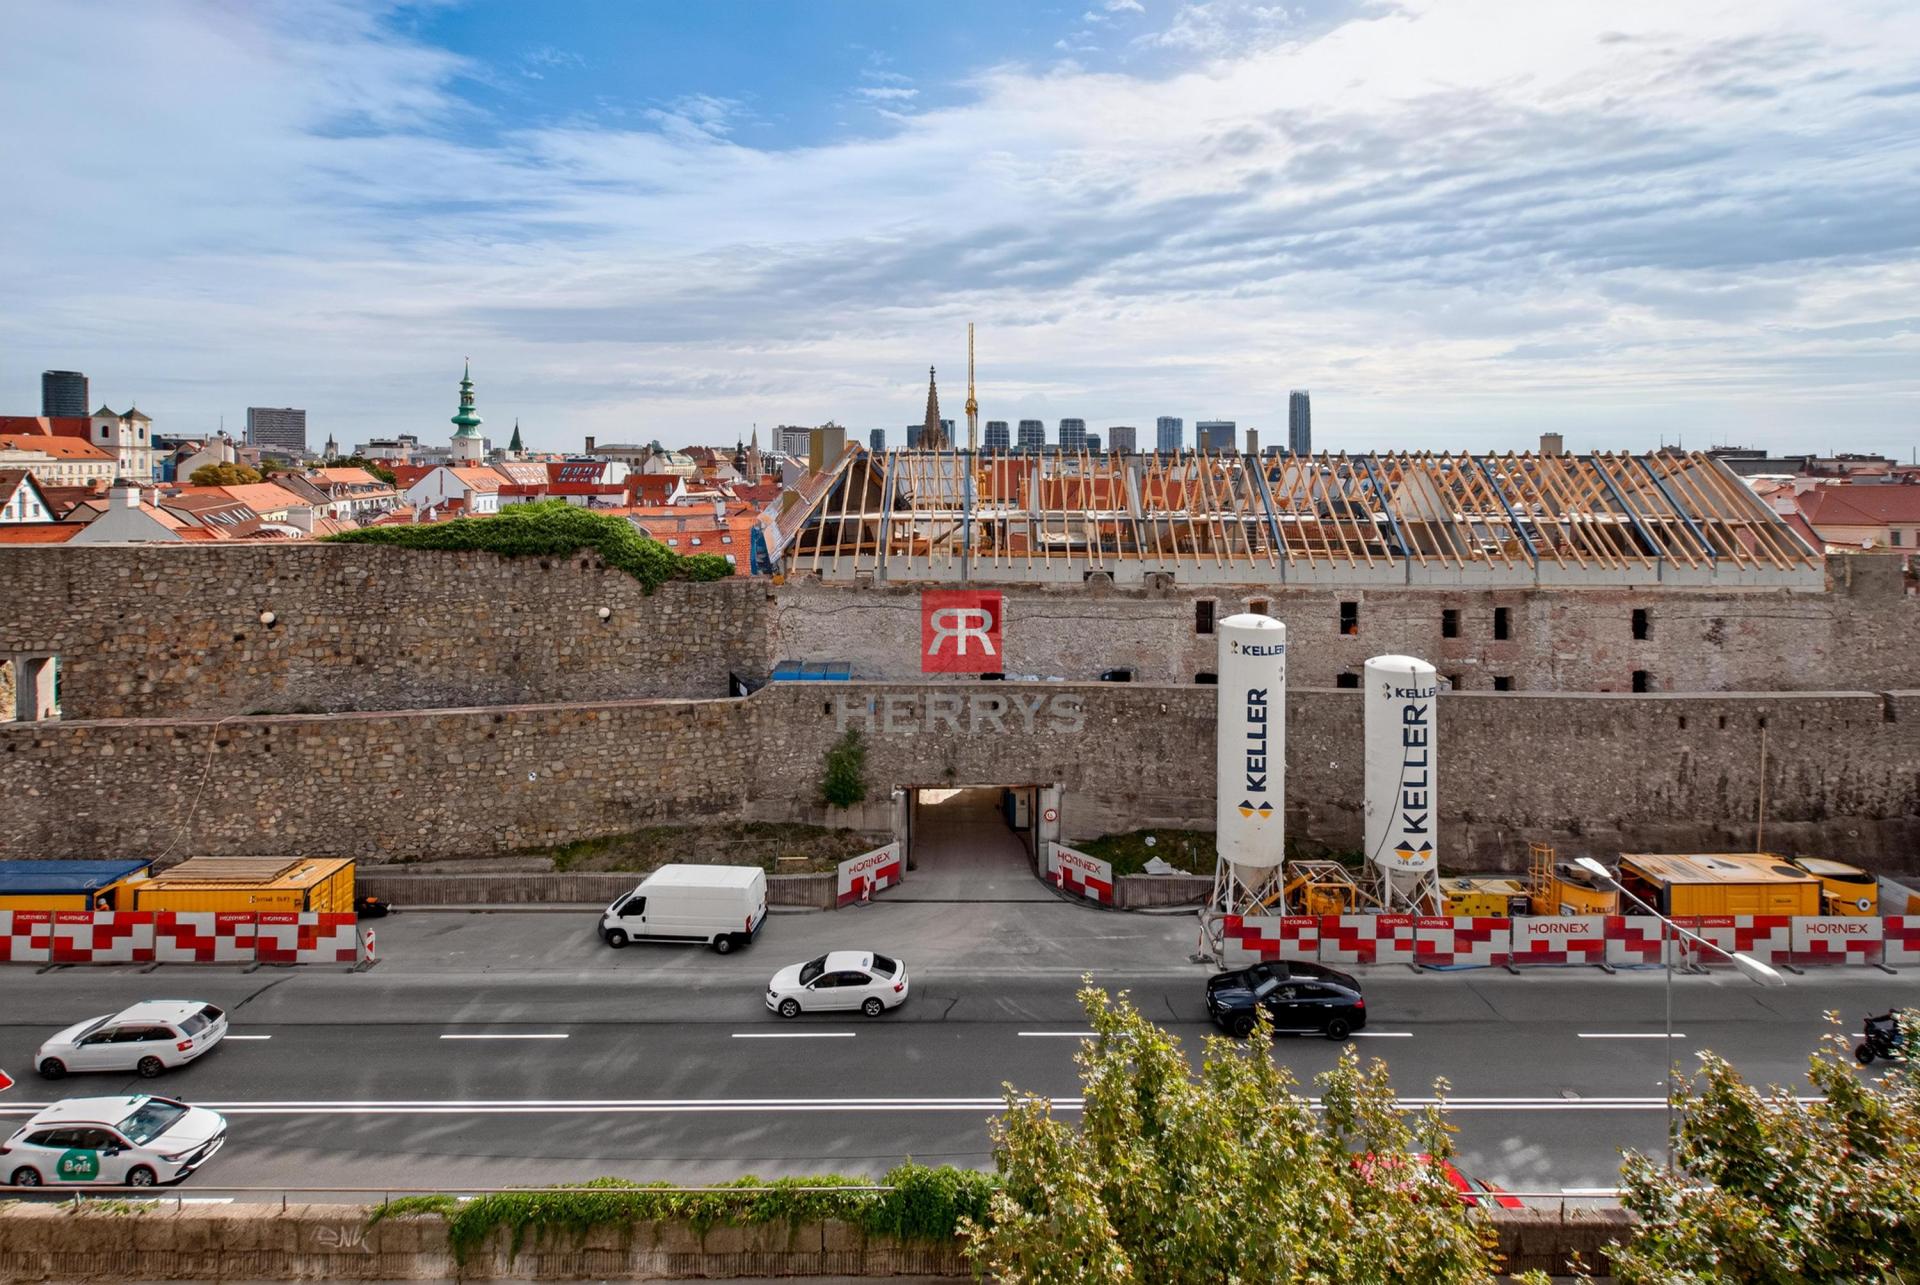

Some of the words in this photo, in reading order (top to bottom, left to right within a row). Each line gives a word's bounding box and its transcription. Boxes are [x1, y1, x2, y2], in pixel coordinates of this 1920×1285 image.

[1395, 687, 1436, 698] KELLE
[1246, 688, 1268, 792] KELLER
[1403, 704, 1428, 834] KELLER
[1528, 923, 1589, 934] HORNEX
[1806, 923, 1868, 934] HORNEX
